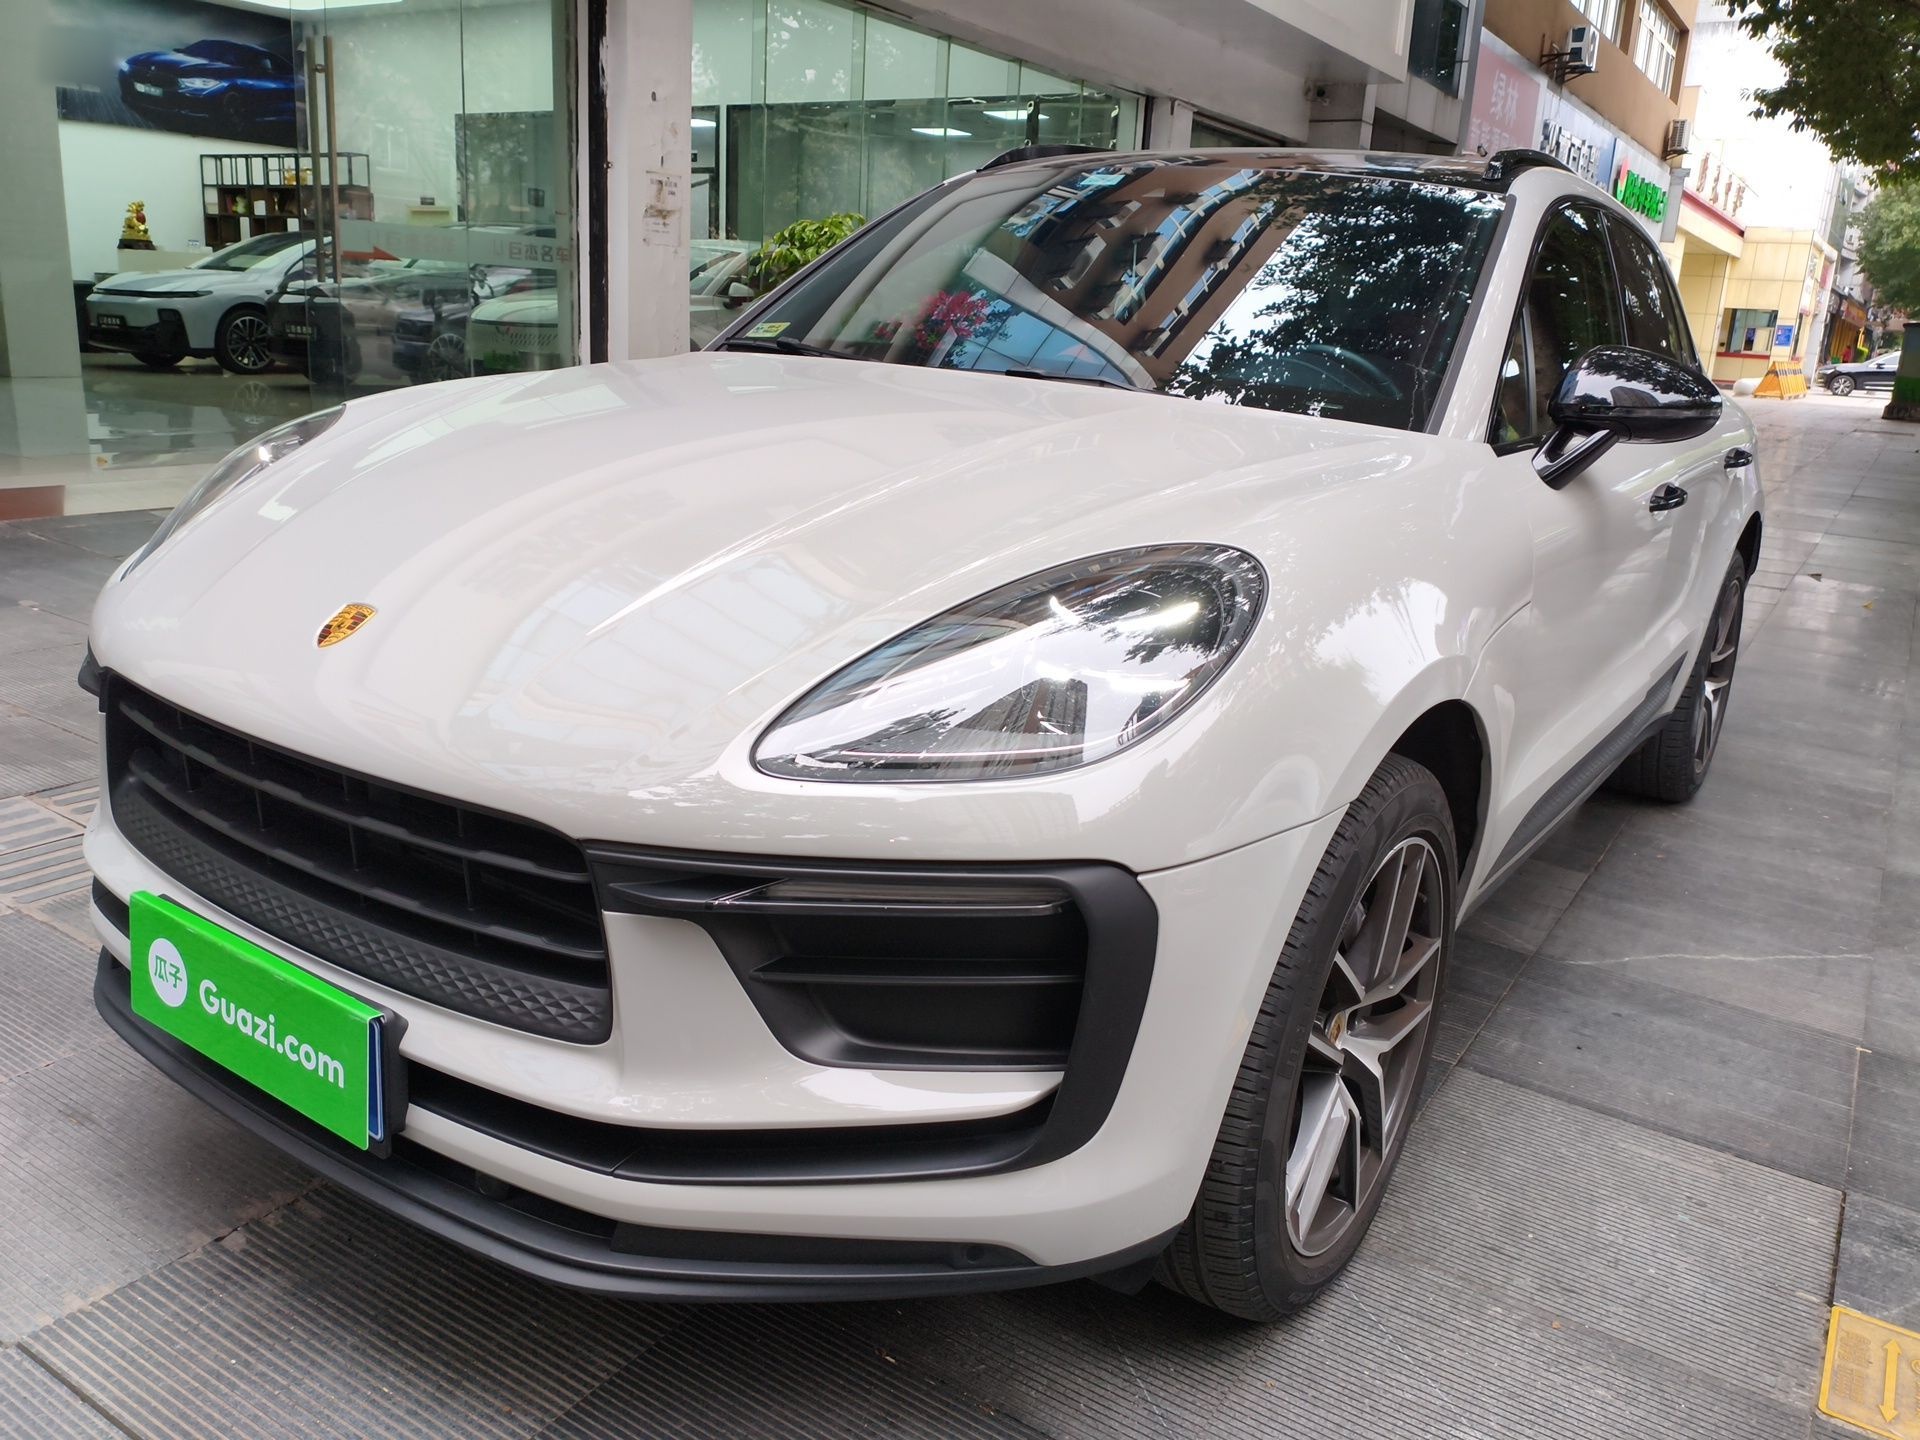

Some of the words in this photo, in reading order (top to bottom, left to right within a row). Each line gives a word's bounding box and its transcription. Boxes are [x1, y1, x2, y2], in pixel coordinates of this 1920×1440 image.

[509, 242, 568, 263] 巨杰名车
[155, 956, 182, 988] 瓜子
[200, 979, 345, 1088] Guazi.com
